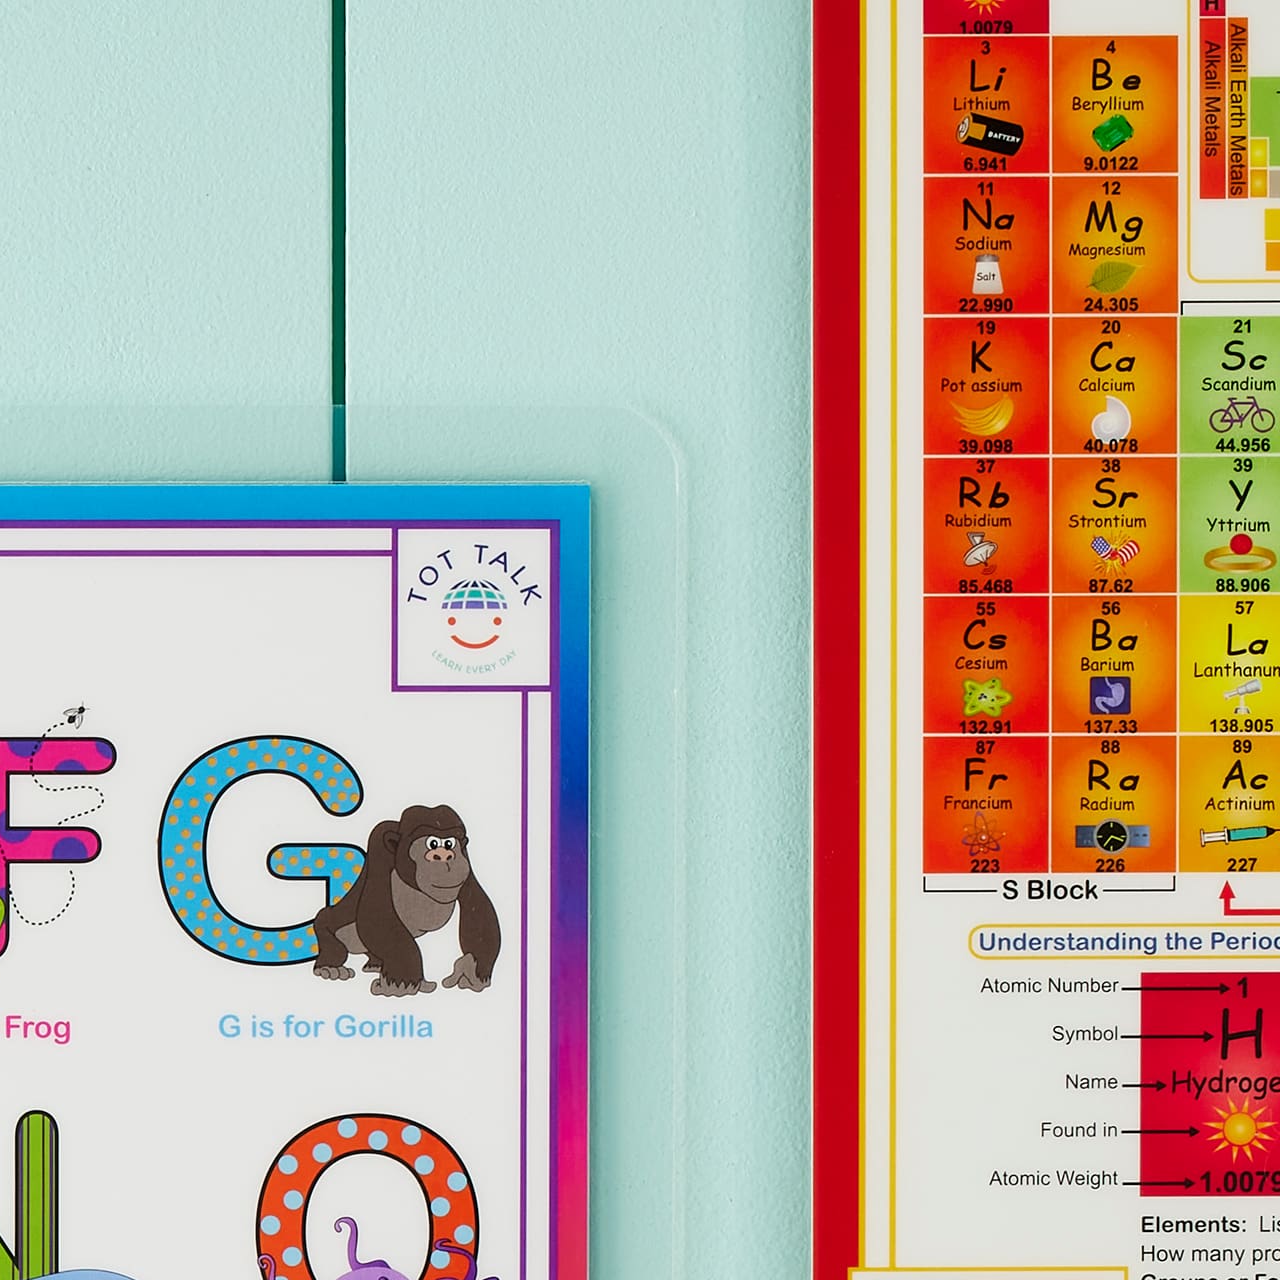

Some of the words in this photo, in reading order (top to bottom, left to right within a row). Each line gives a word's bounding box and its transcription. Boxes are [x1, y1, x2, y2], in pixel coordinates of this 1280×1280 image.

[983, 41, 990, 54] 3
[1107, 41, 1115, 53] 4
[1231, 24, 1246, 72] Alkali
[1206, 42, 1218, 89] Alkali
[971, 60, 1006, 91] Li
[1093, 59, 1140, 90] Be
[954, 97, 1009, 110] Lithium
[1073, 96, 1143, 114] Beryllium
[1231, 80, 1246, 127] Earth
[1206, 97, 1218, 156] Metals
[964, 158, 1005, 170] 6.941
[1085, 157, 1137, 170] 9.0122
[1231, 136, 1246, 195] Metals
[979, 182, 992, 195] 11
[964, 199, 1014, 230] Na
[1085, 201, 1143, 242] Mg
[956, 237, 1011, 250] Sodium
[1069, 244, 1145, 259] Magnesium
[976, 272, 996, 281] Salt
[960, 299, 1012, 312] 22.990
[1085, 298, 1138, 311] 24.305
[972, 342, 992, 373] K
[1079, 378, 1134, 391] Calcium
[1202, 376, 1276, 391] Scandium
[960, 440, 1012, 453] 39.098
[1084, 439, 1137, 452] 40.078
[1216, 438, 1270, 452] 44.956
[946, 514, 1011, 526] Rubidium
[1070, 515, 1146, 527] Strontium
[1207, 518, 1270, 532] Yttrium
[407, 550, 453, 602] TOT
[474, 544, 542, 606] TALK
[1216, 578, 1270, 592] 88.906
[431, 650, 463, 672] LEARN
[466, 663, 497, 674] EVERY
[499, 650, 518, 666] DAY
[956, 657, 1007, 669] Cesium
[1082, 657, 1134, 671] Barium
[1211, 719, 1273, 732] 138.905
[945, 796, 1012, 809] Francium
[1081, 798, 1134, 810] Radium
[1205, 798, 1274, 810] Actinium
[1228, 858, 1257, 871] 227
[1003, 880, 1018, 899] S
[1028, 880, 1097, 899] Block
[980, 933, 1156, 955] Understanding
[1165, 932, 1202, 950] the
[981, 978, 1041, 993] Atomic
[1049, 978, 1119, 992] Number
[219, 1015, 240, 1037] G
[252, 1016, 274, 1037] is
[283, 1015, 325, 1038] for
[335, 1015, 432, 1037] Gorilla
[1053, 1026, 1117, 1045] Symbol
[1066, 1074, 1117, 1089] Name
[1042, 1122, 1096, 1137] Found
[1104, 1121, 1117, 1136] in
[989, 1171, 1050, 1185] Atomic
[1057, 1171, 1117, 1189] Weight
[1142, 1216, 1246, 1232] Elements:
[1142, 1245, 1184, 1262] How
[1192, 1249, 1245, 1266] many
